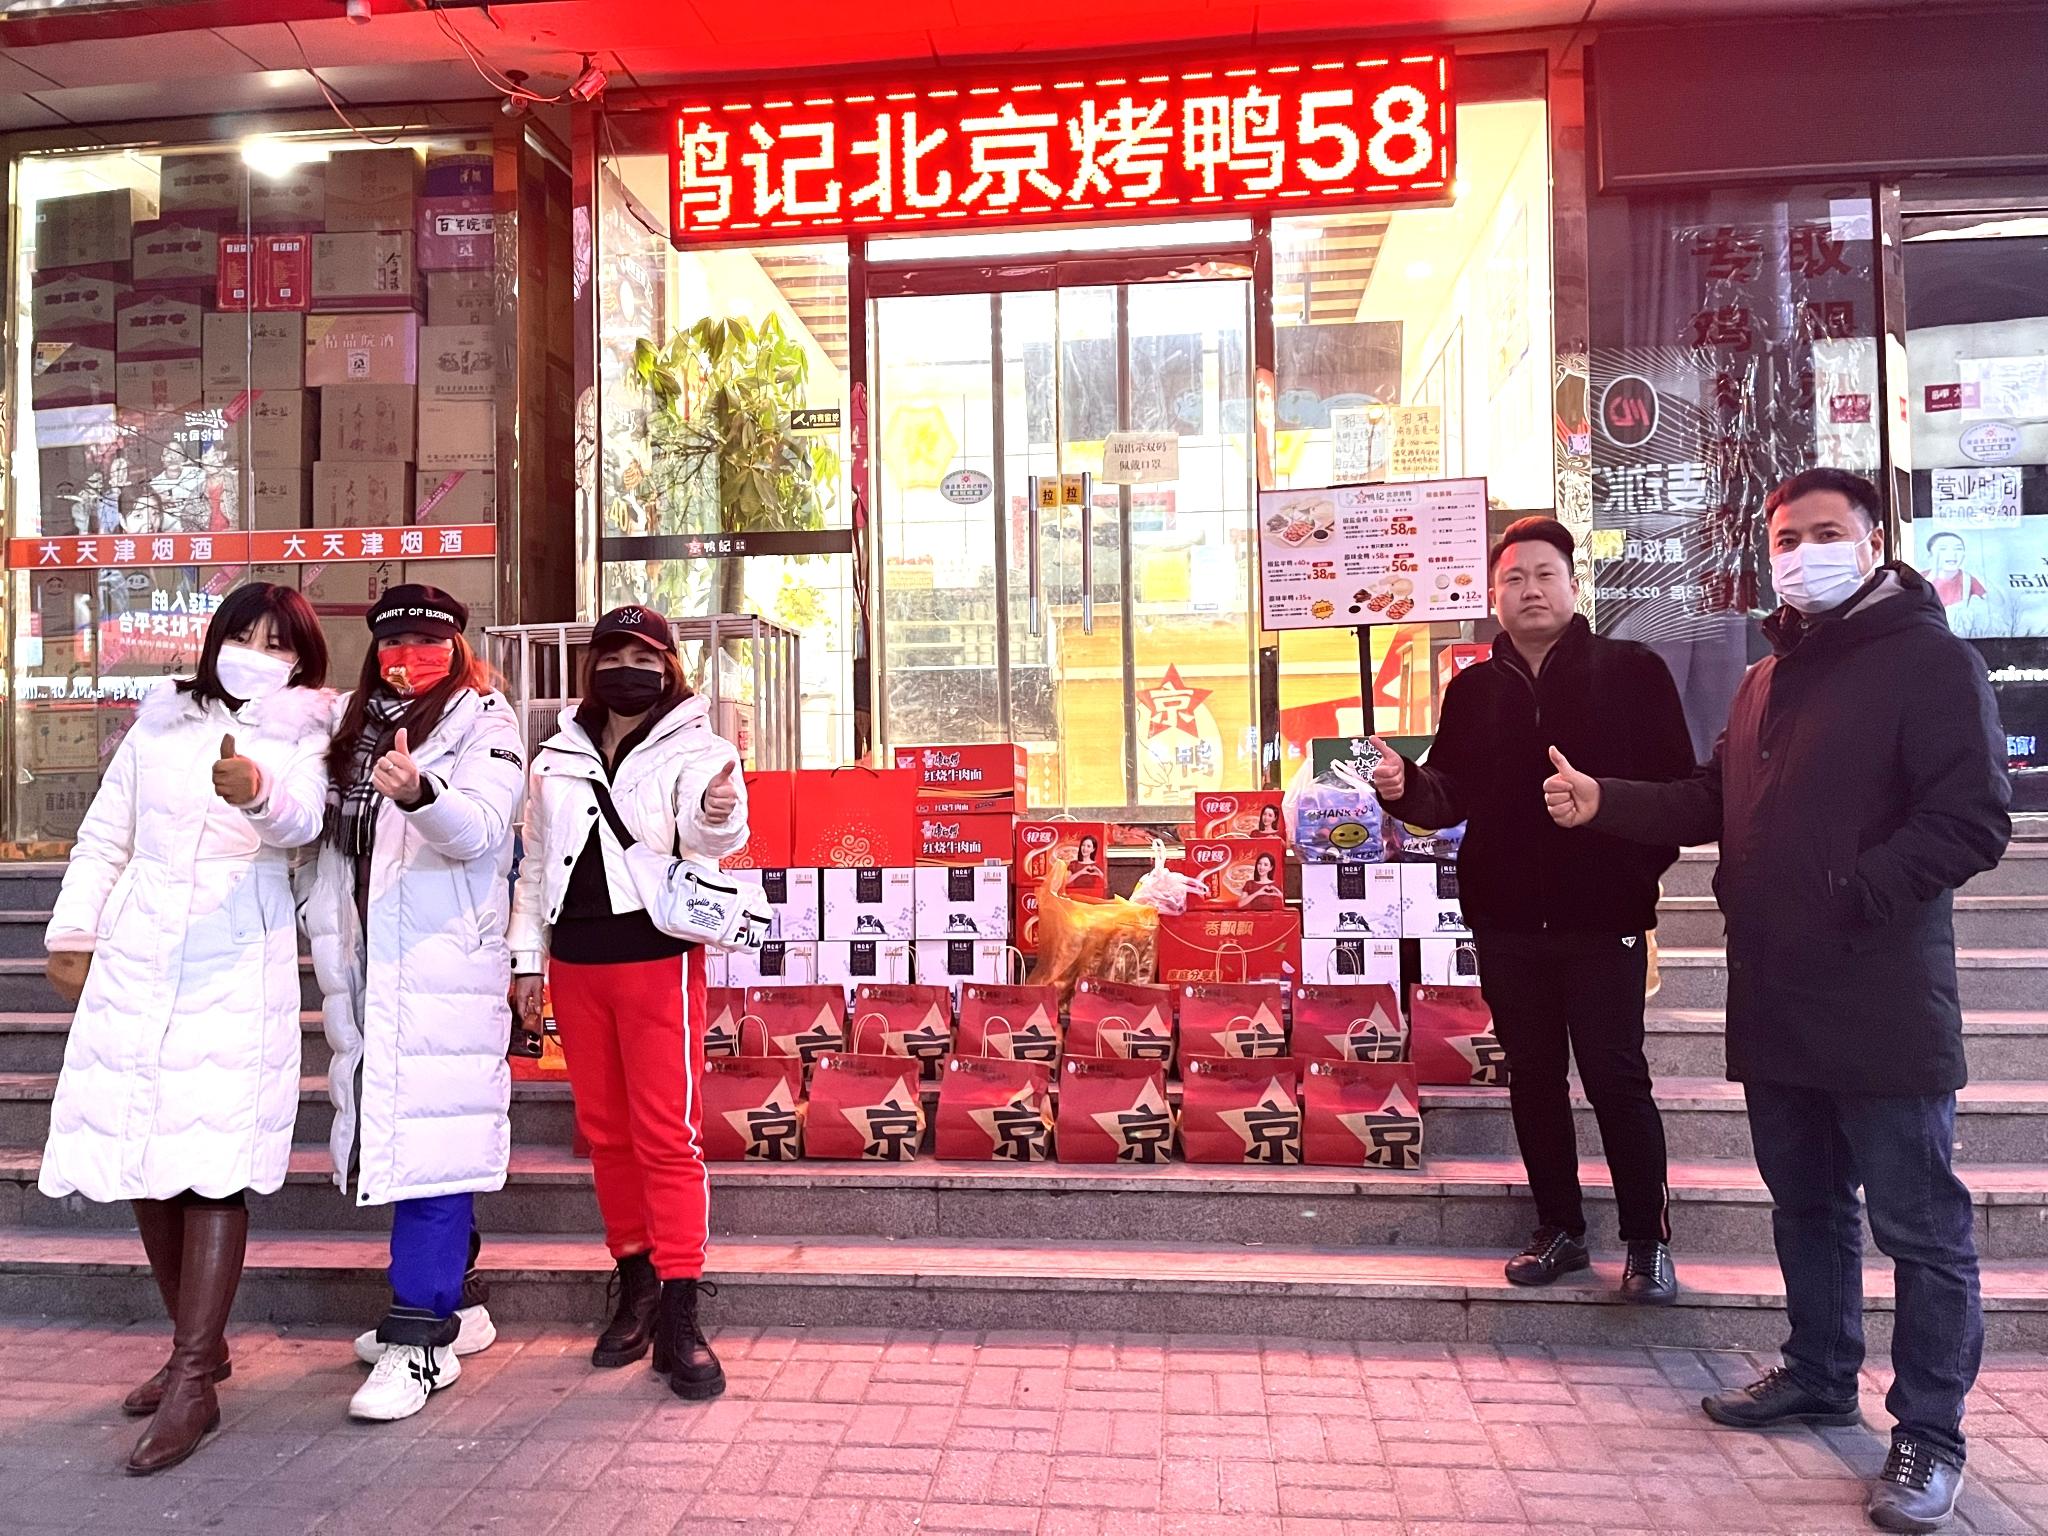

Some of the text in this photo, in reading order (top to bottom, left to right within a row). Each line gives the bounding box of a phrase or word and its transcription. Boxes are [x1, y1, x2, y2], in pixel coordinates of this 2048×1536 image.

[1043, 489, 1054, 501] 拉
[1066, 487, 1077, 498] 拉
[1937, 474, 2017, 500] 营业时间
[39, 537, 213, 564] 大天津烟酒
[283, 530, 462, 558] 大天津烟酒
[408, 607, 424, 617] OF
[924, 768, 982, 782] 红烧牛肉面
[923, 841, 982, 854] 红烧牛肉面
[733, 925, 762, 948] FIL
[1205, 920, 1254, 937] 香飘飘
[903, 1025, 950, 1080] 京
[745, 1101, 797, 1160] 京
[863, 1098, 918, 1161] 京
[992, 1099, 1047, 1162] 京
[1116, 1103, 1170, 1164] 京
[1244, 1099, 1299, 1164] 京
[1364, 1105, 1420, 1168] 京
